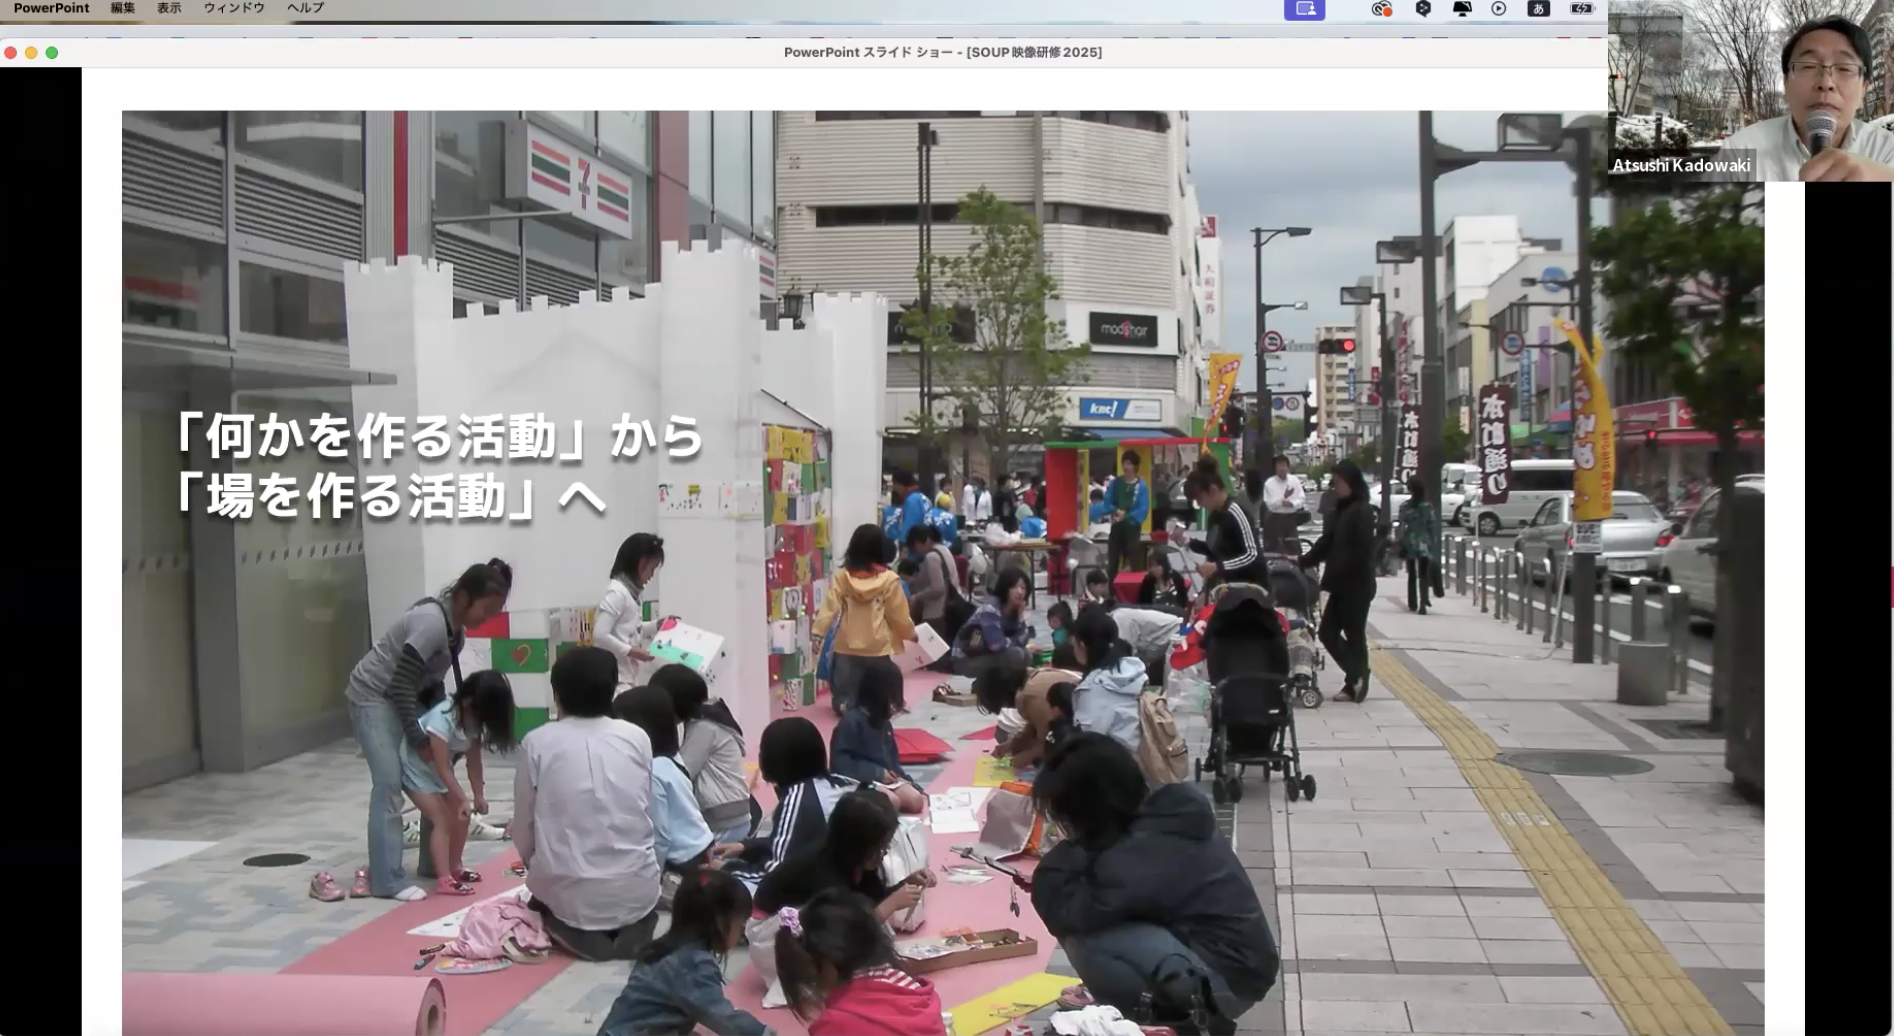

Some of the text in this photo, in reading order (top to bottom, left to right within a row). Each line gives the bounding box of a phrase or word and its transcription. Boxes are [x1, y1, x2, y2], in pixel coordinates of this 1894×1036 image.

[14, 1, 90, 14] PowerPoint
[110, 1, 136, 14] 編集
[157, 1, 182, 14] 表示
[204, 2, 265, 14] ウィンドウ
[287, 2, 325, 14] ヘルプ
[1533, 3, 1544, 15] あ
[784, 46, 860, 58] PowerPoint
[864, 46, 912, 59] スライド
[917, 46, 953, 59] ショー
[1481, 393, 1508, 496] 本町通り
